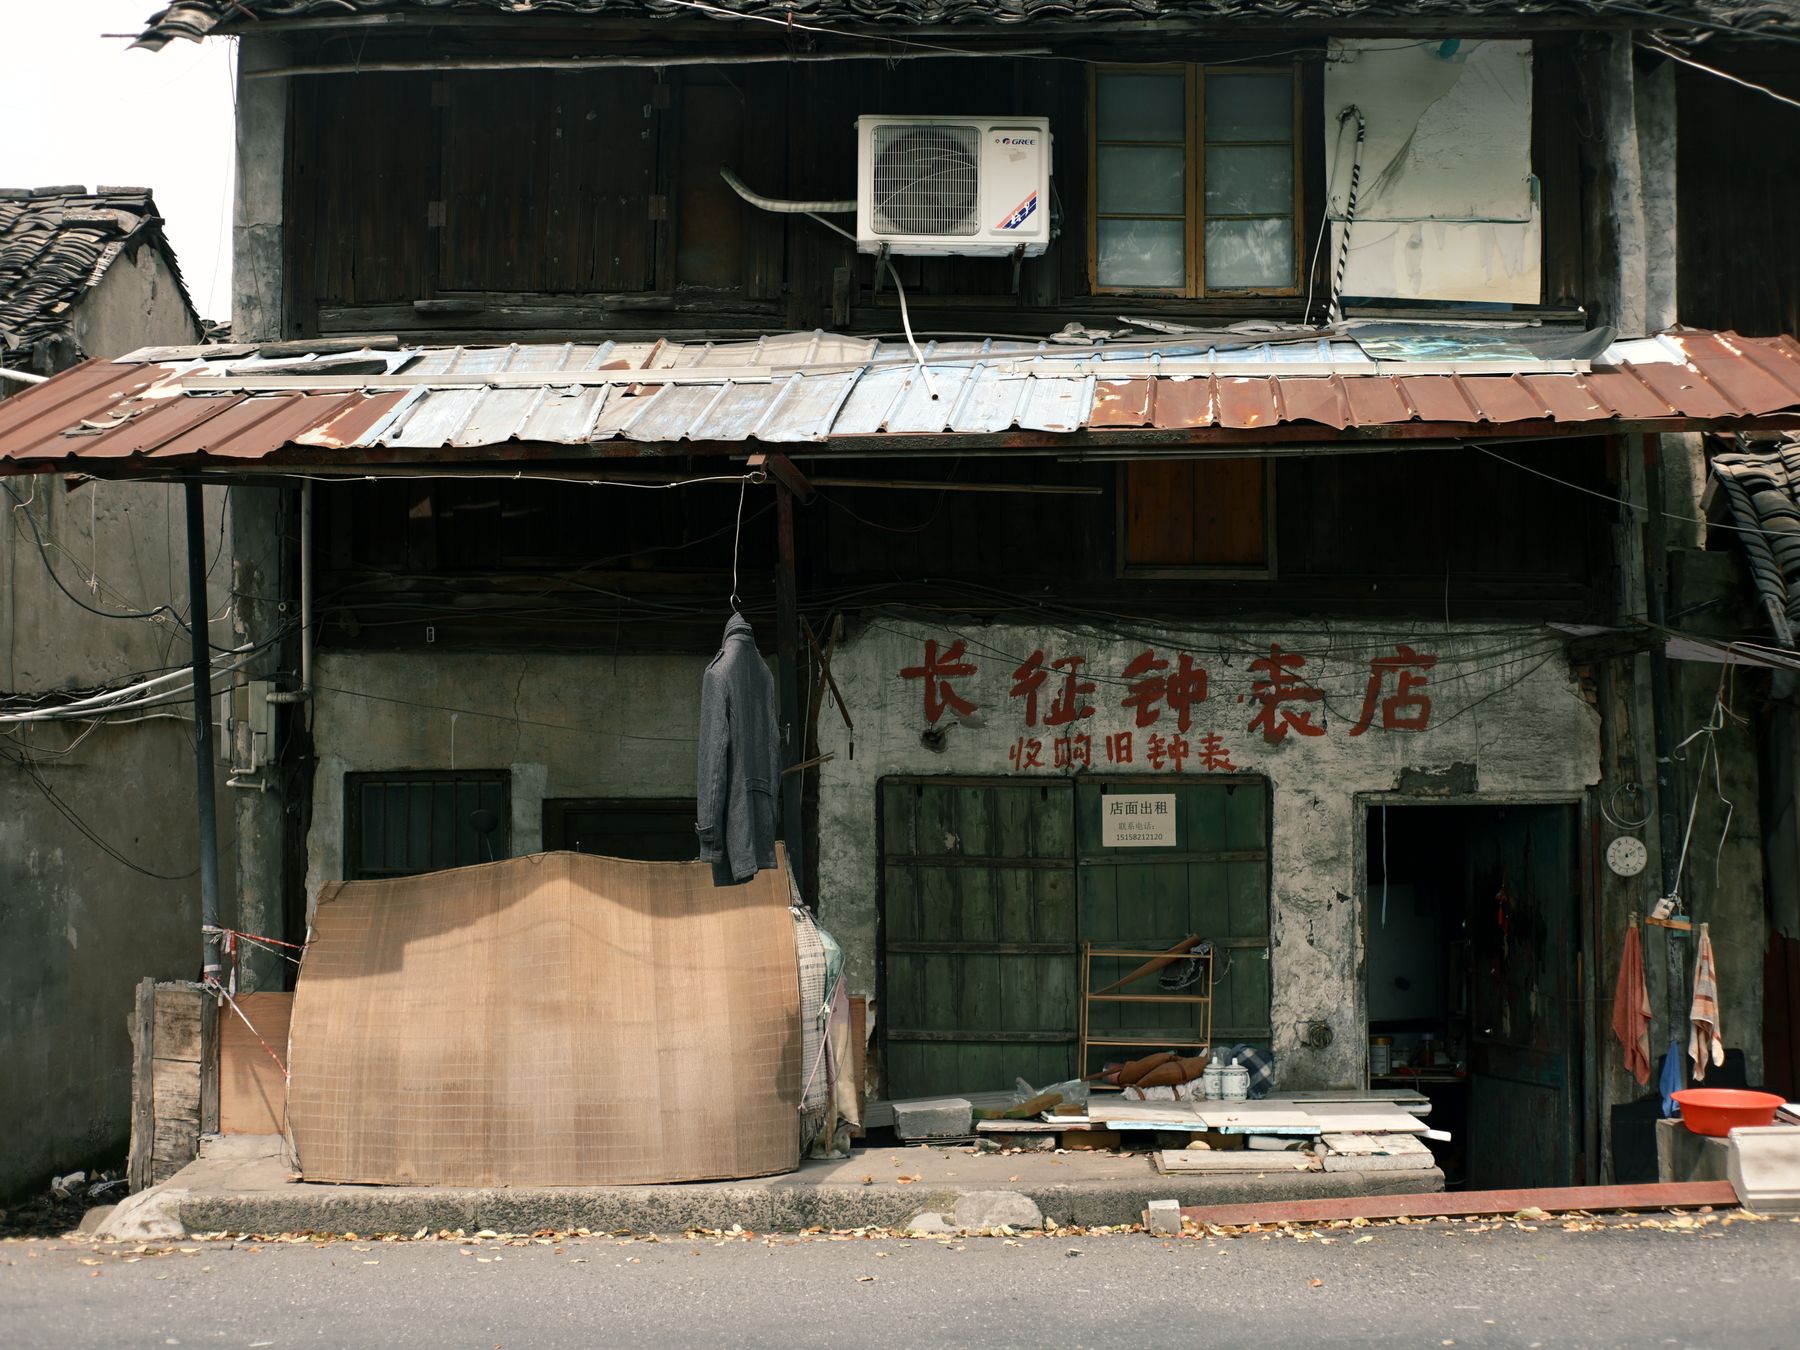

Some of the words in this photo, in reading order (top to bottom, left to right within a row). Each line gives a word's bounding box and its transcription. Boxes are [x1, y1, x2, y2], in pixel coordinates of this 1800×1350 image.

[901, 639, 1437, 744] 长征钟表店
[1009, 731, 1238, 775] 收购旧钟表
[1110, 801, 1168, 815] 店面出租
